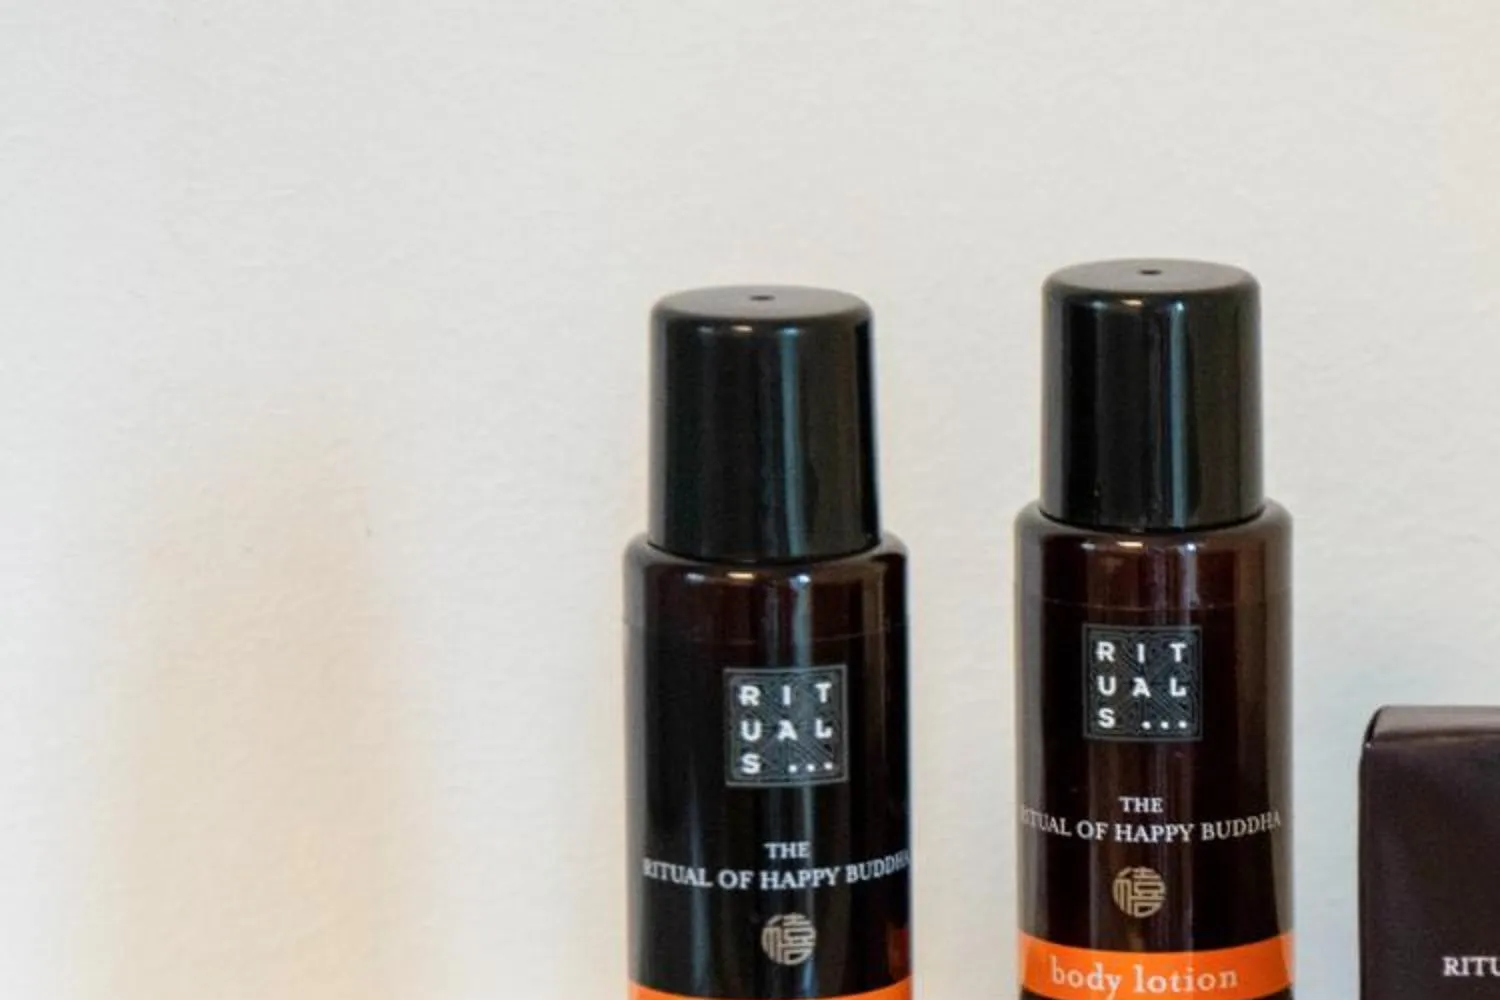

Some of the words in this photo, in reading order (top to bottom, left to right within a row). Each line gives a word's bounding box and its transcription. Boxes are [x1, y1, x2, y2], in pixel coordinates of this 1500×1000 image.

[1118, 796, 1164, 813] THE
[1077, 819, 1108, 840] OF
[1114, 823, 1194, 843] HAPPY
[1201, 810, 1281, 841] BUDDHA
[764, 841, 811, 859] THE
[643, 857, 713, 888] RITUAL
[718, 870, 753, 889] OF
[760, 867, 840, 890] HAPPY
[846, 848, 911, 883] BUDDH
[1051, 955, 1122, 1000] body
[1132, 964, 1239, 995] lotion
